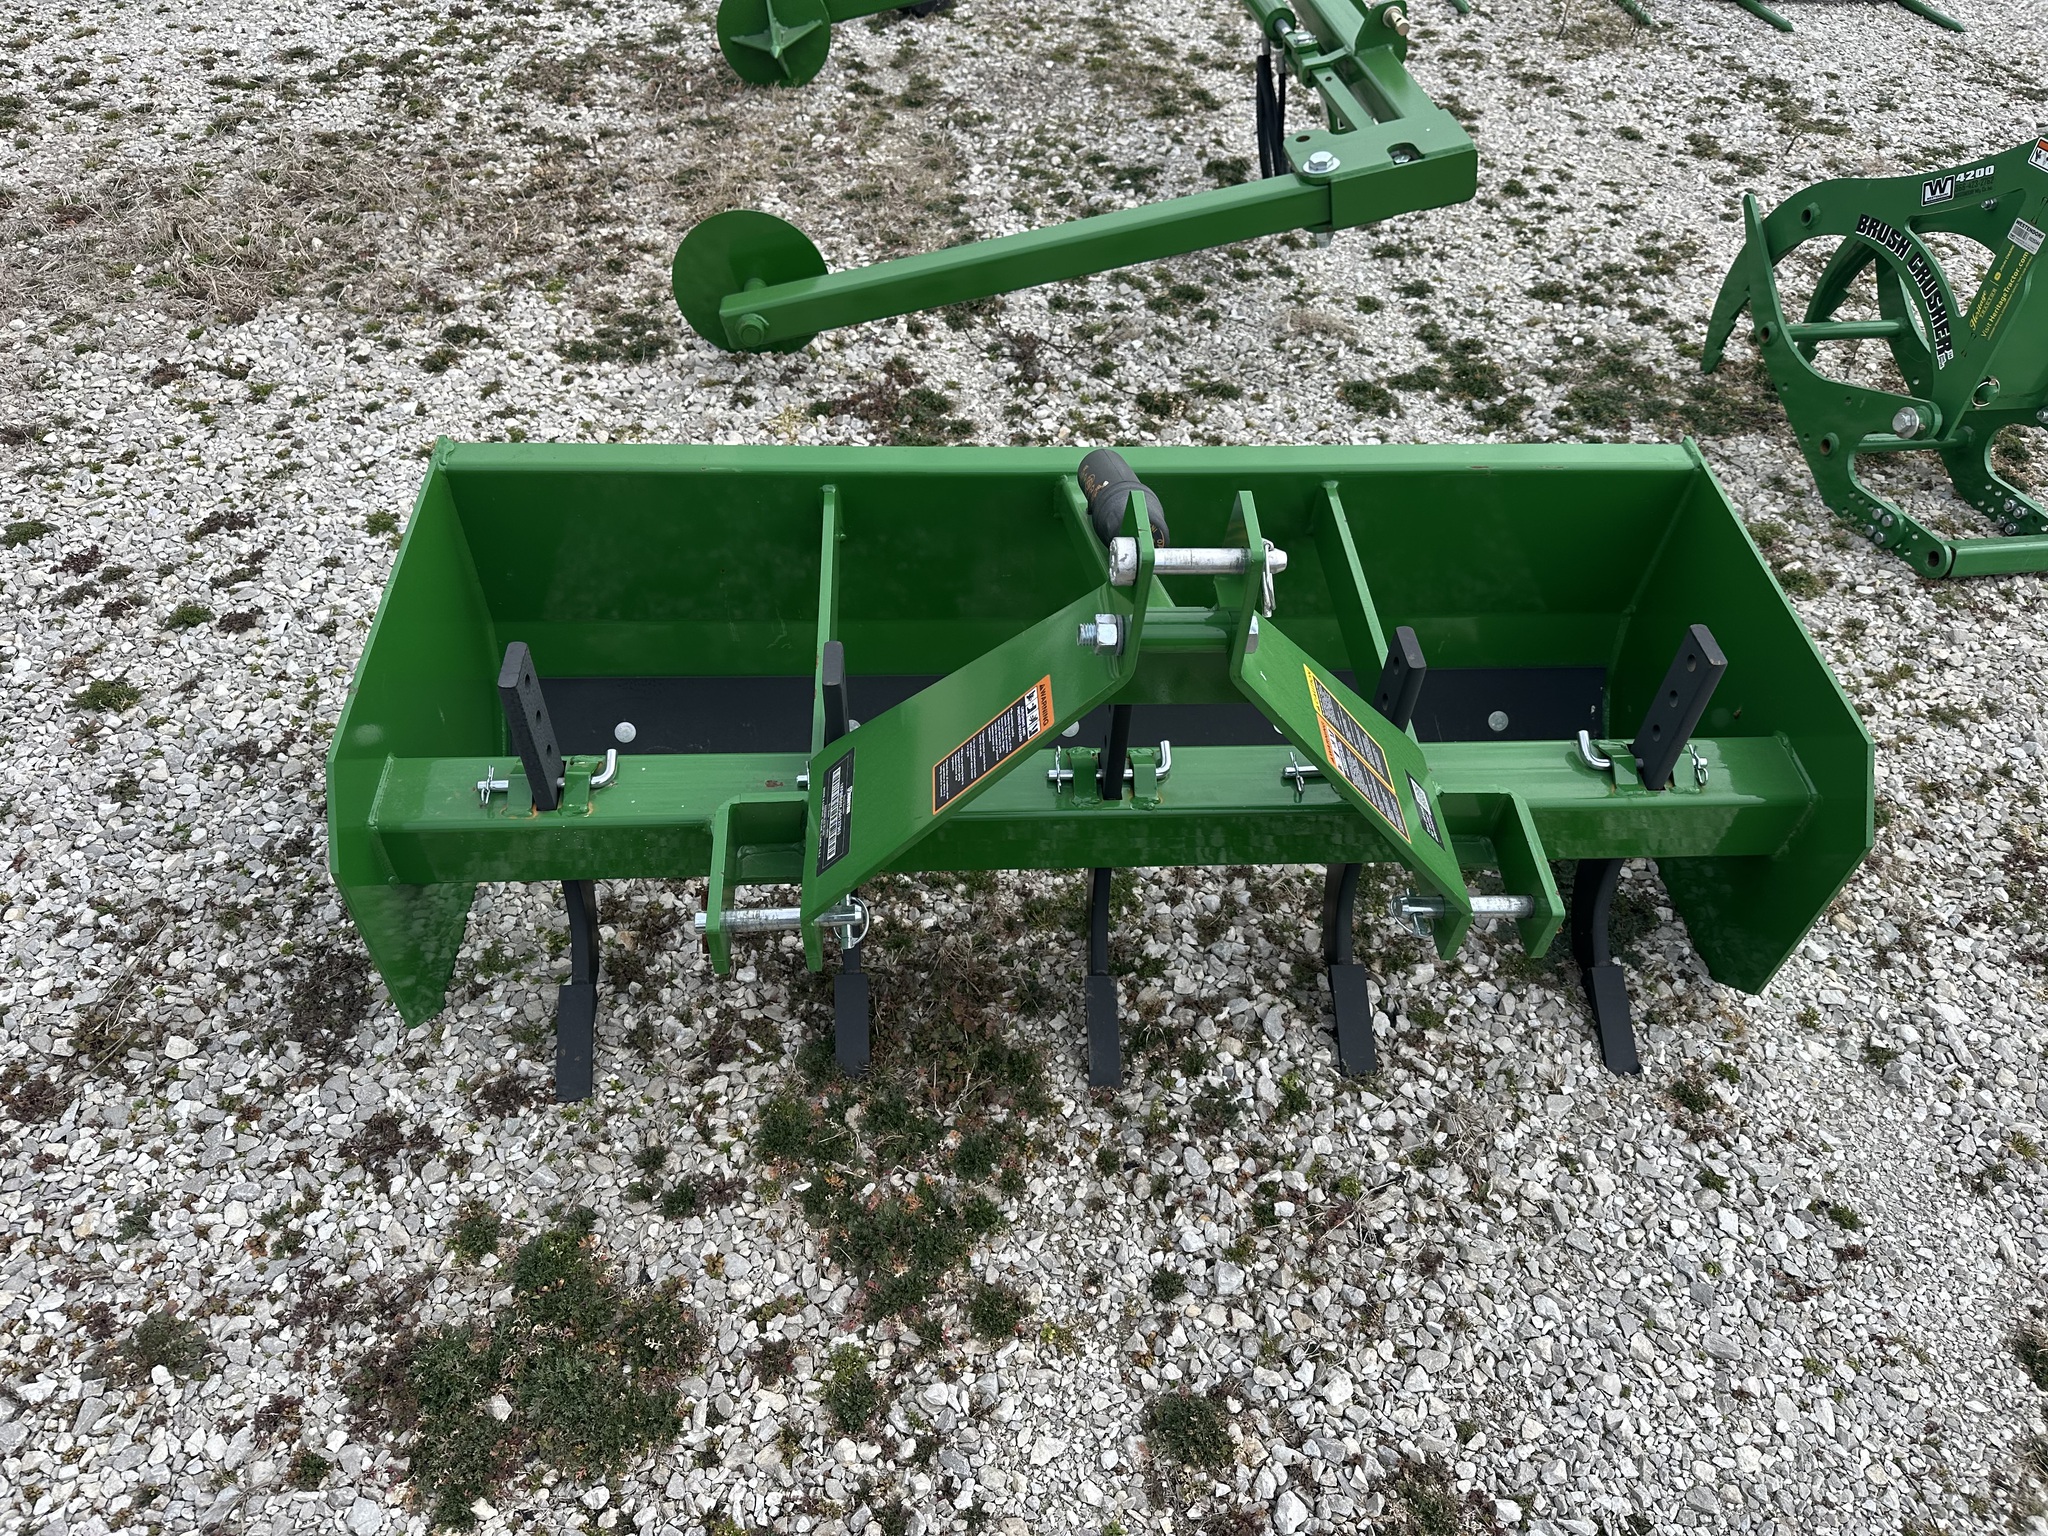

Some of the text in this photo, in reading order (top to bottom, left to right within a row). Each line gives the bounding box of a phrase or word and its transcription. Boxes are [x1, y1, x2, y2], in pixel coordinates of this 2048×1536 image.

[1956, 165, 1995, 182] 4200
[2015, 219, 2044, 239] WESTENDORF
[1856, 213, 1953, 358] BRUSH CRUSHER
[1981, 323, 1992, 337] Visit
[1988, 251, 2029, 324] HeritageTractor.com
[1969, 290, 1987, 331] Heritage
[1040, 686, 1049, 727] WARNING
